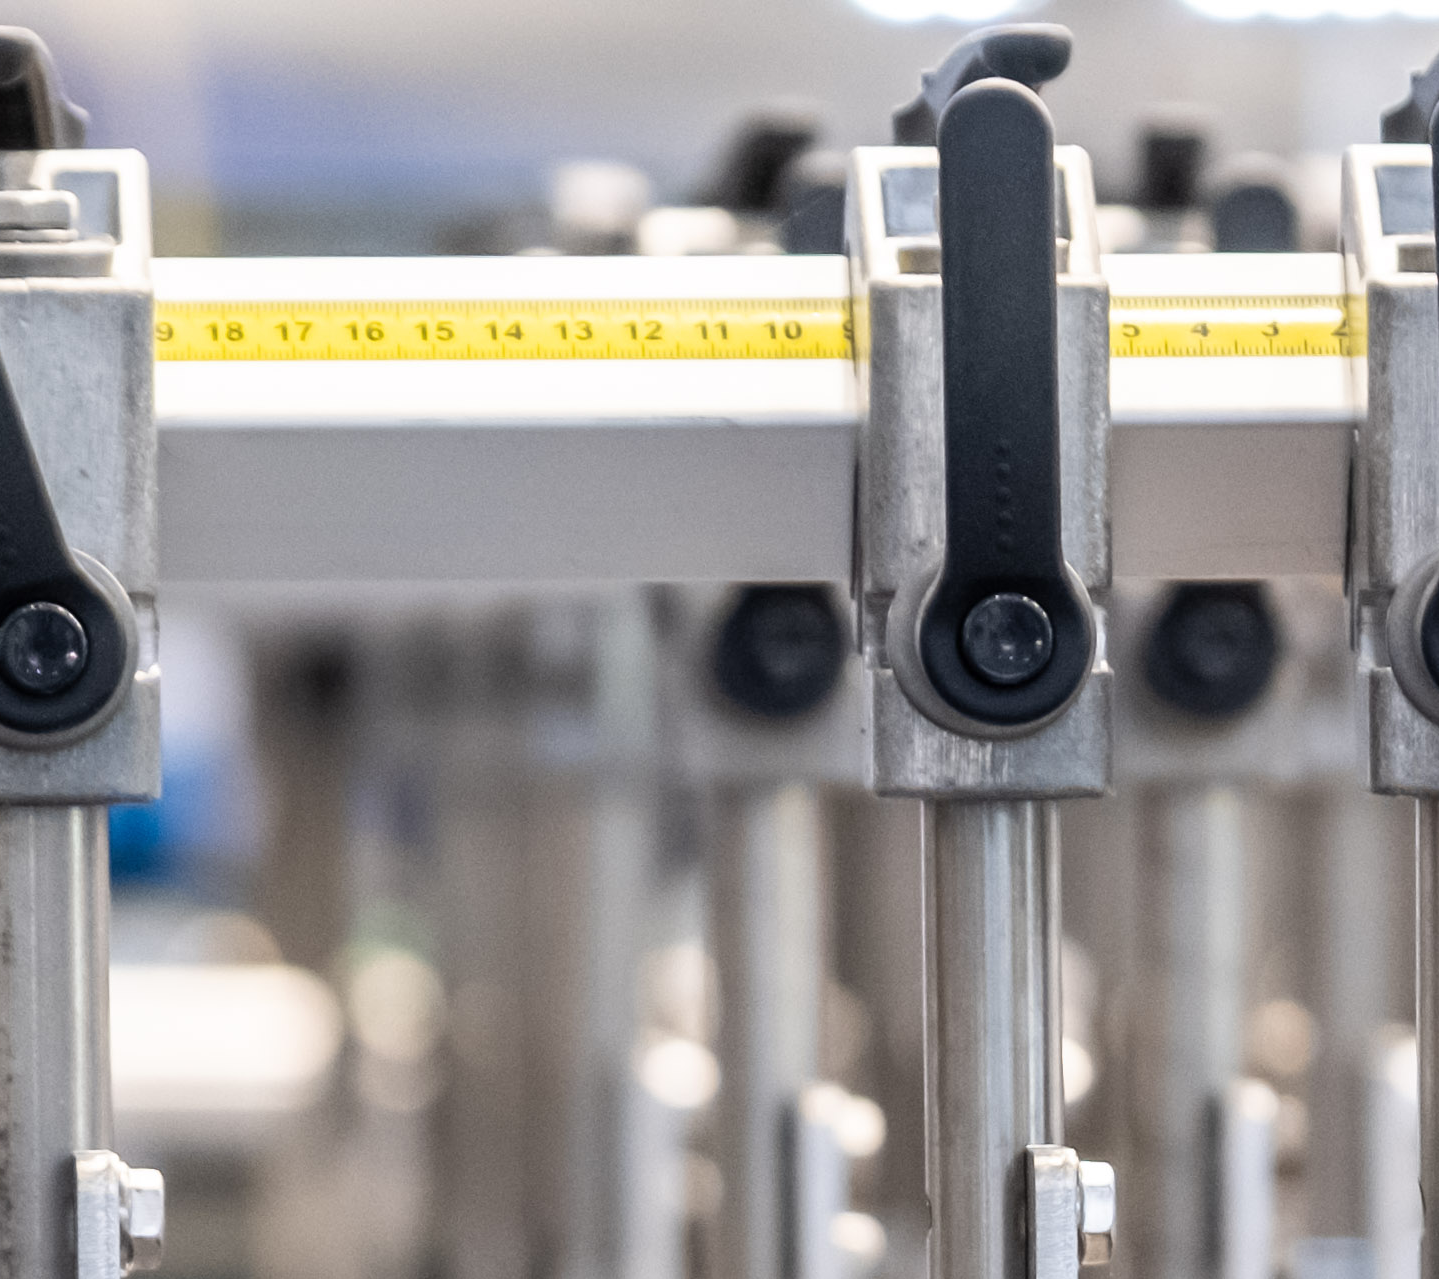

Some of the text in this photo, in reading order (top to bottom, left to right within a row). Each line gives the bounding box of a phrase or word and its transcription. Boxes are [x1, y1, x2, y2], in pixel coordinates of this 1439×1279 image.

[155, 322, 174, 343] 9
[205, 322, 245, 342] 18
[275, 322, 313, 342] 17
[345, 322, 385, 342] 16
[415, 322, 454, 342] 15
[484, 321, 525, 341] 14
[554, 320, 593, 341] 13
[624, 320, 663, 341] 12
[695, 320, 729, 341] 11
[763, 319, 803, 340] 10
[1190, 321, 1211, 338] 4
[1261, 321, 1280, 338] 3
